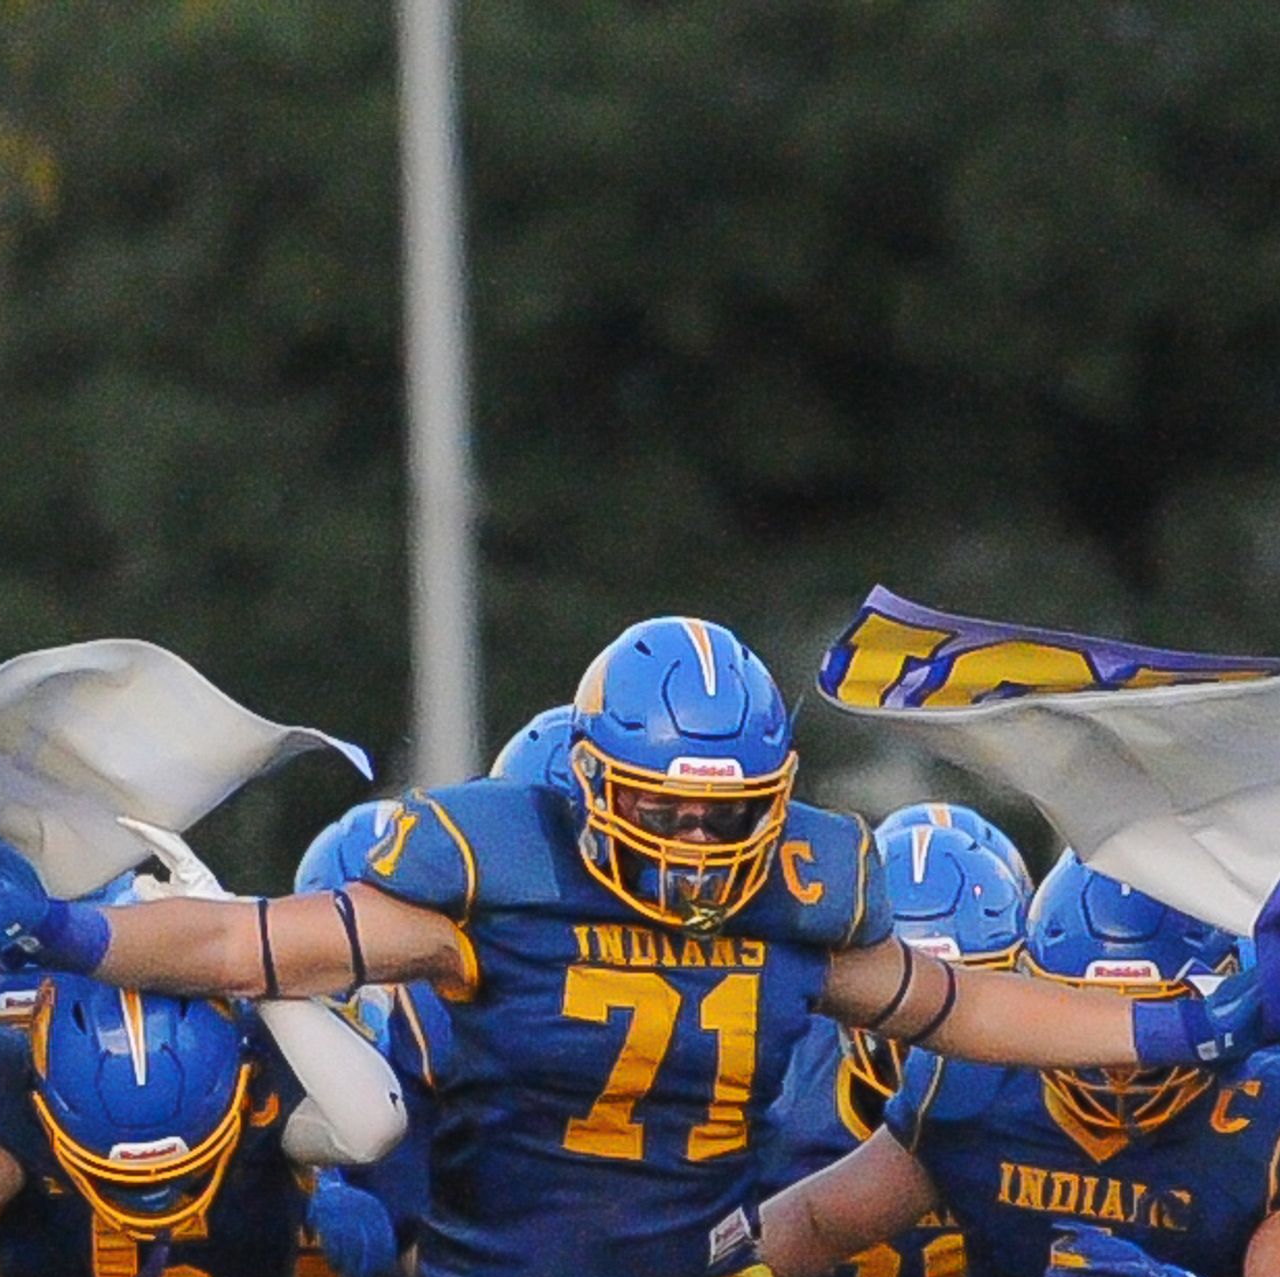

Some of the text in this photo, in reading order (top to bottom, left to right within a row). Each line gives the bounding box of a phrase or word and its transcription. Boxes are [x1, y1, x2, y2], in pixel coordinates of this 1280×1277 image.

[780, 841, 823, 905] C
[574, 924, 766, 967] INDIANS
[562, 966, 759, 1162] 71
[1210, 1080, 1262, 1134] C
